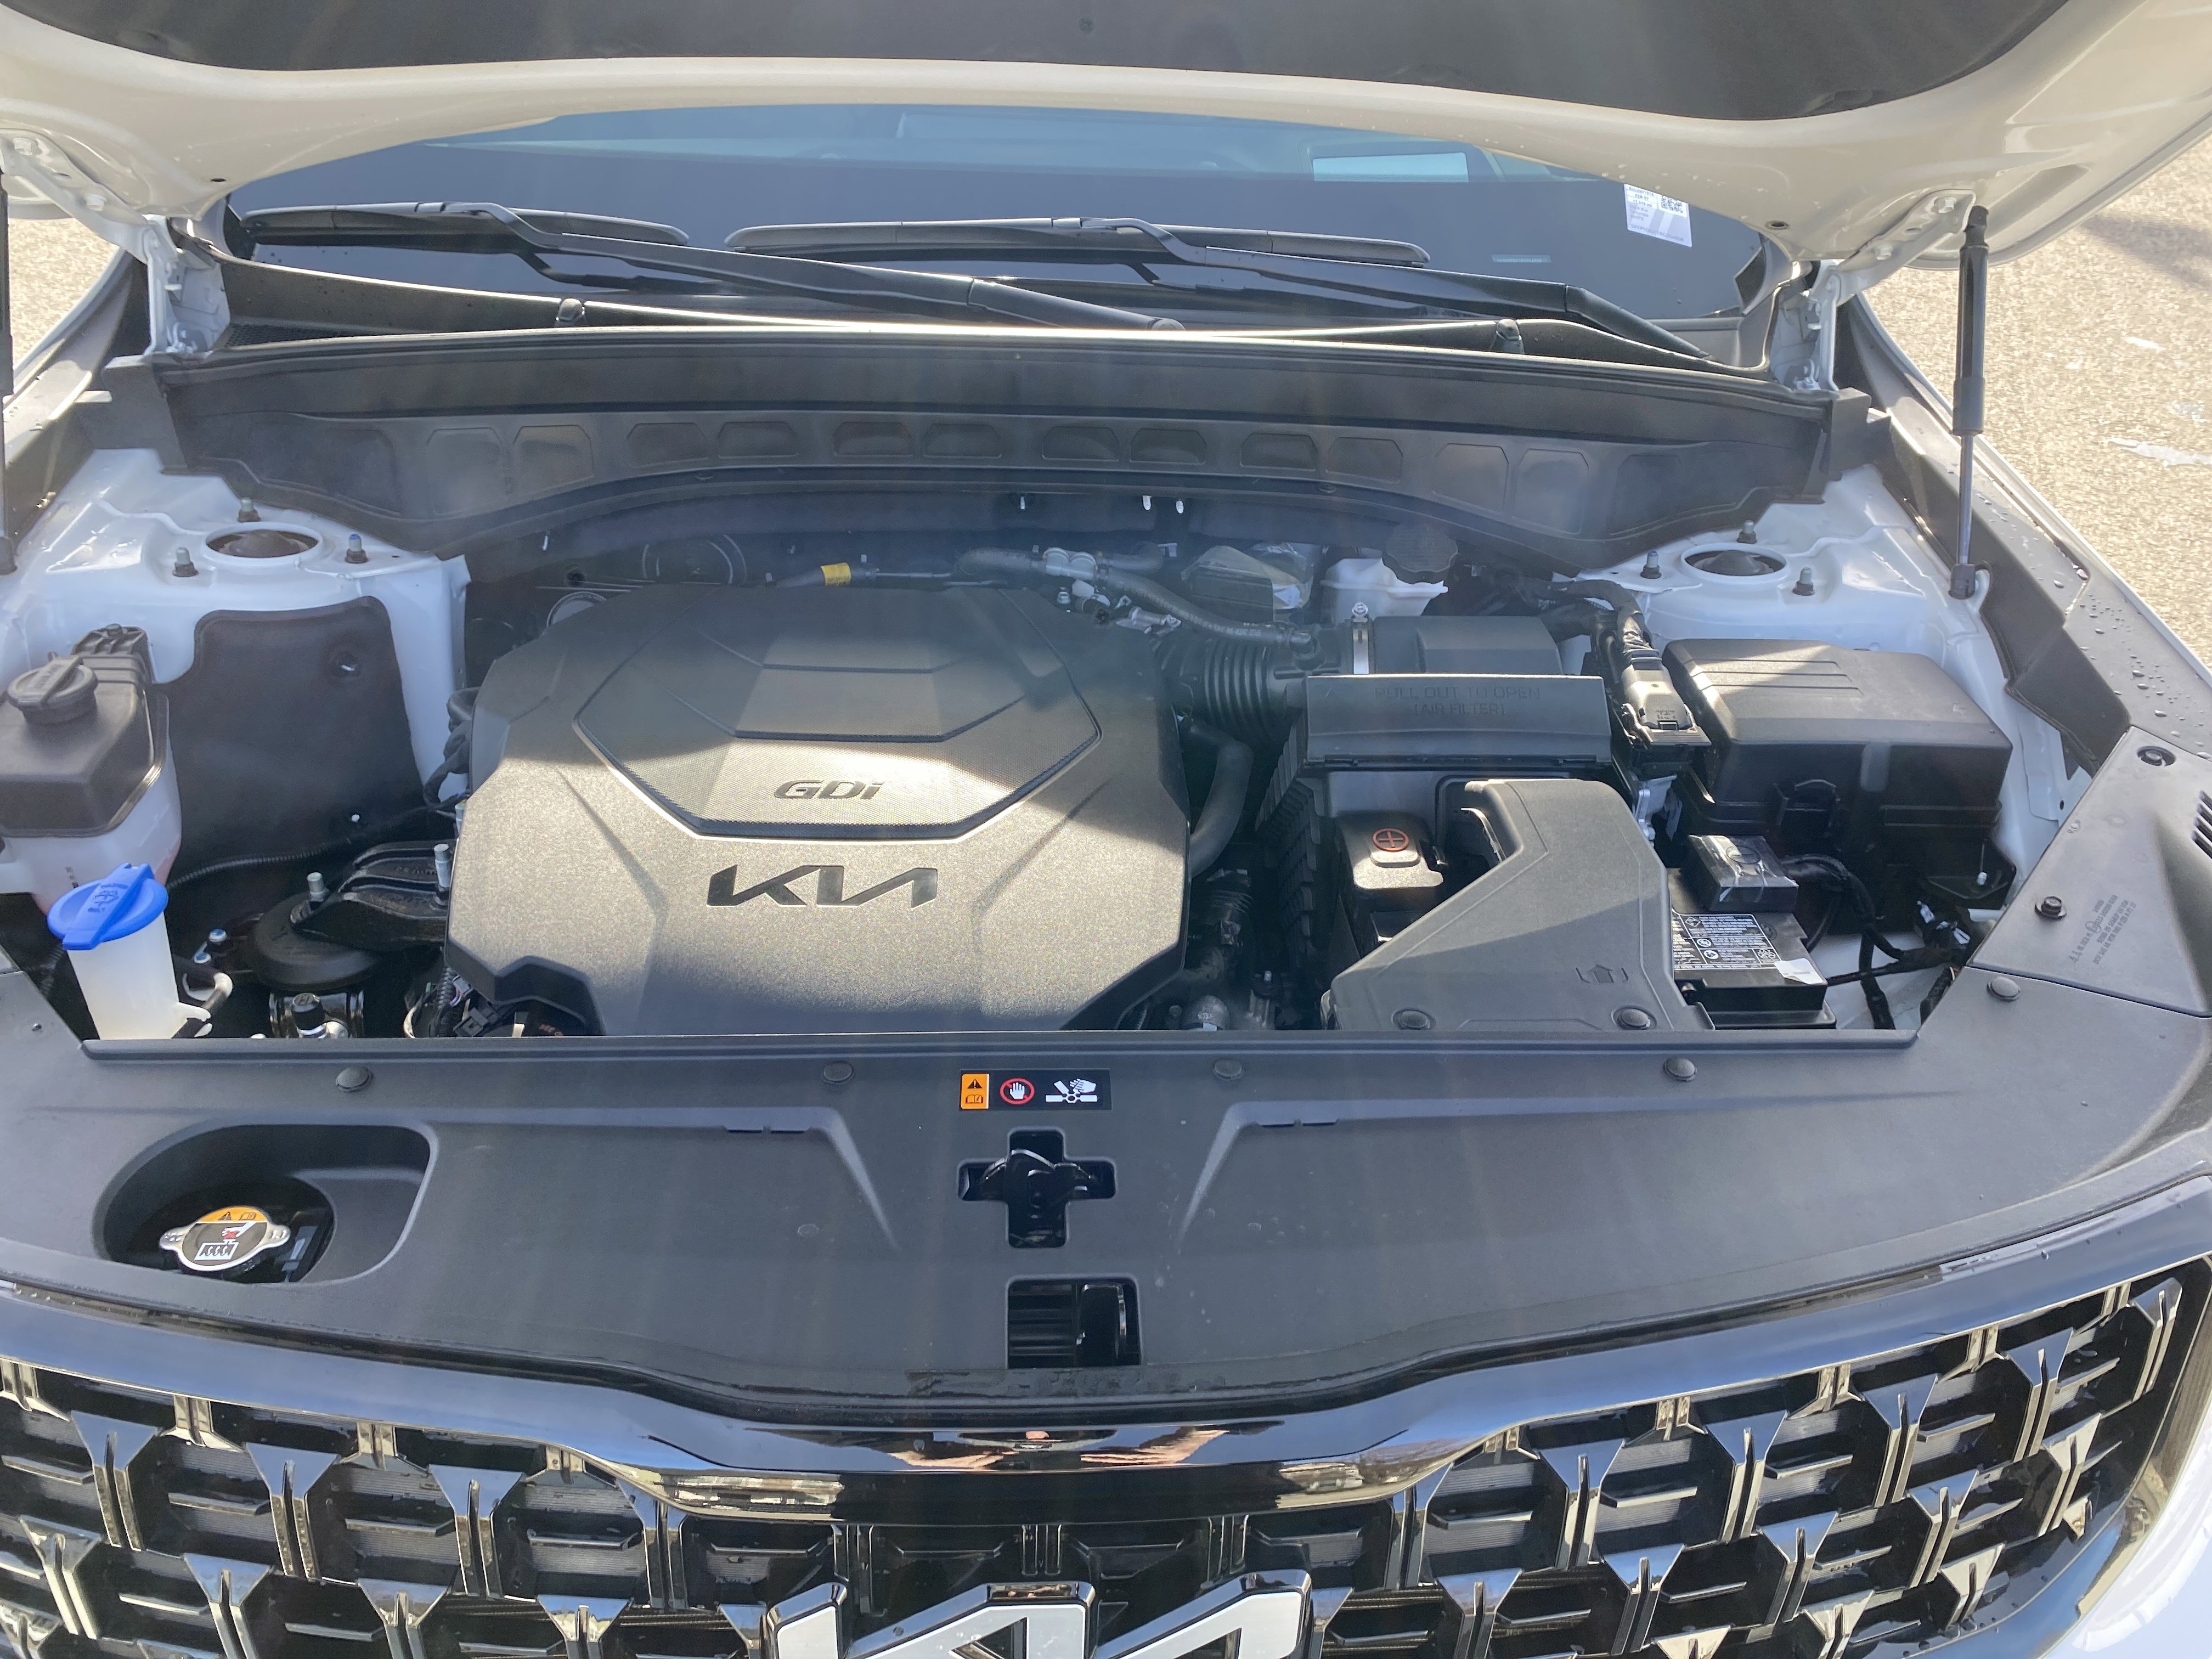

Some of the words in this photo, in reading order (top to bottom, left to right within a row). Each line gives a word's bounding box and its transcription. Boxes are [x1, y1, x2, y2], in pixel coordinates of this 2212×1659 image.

[1375, 686, 1418, 699] PULL
[1424, 686, 1459, 699] OUT
[1468, 687, 1488, 699] TO
[1493, 687, 1540, 700] OPEN
[707, 864, 938, 909] KIA
